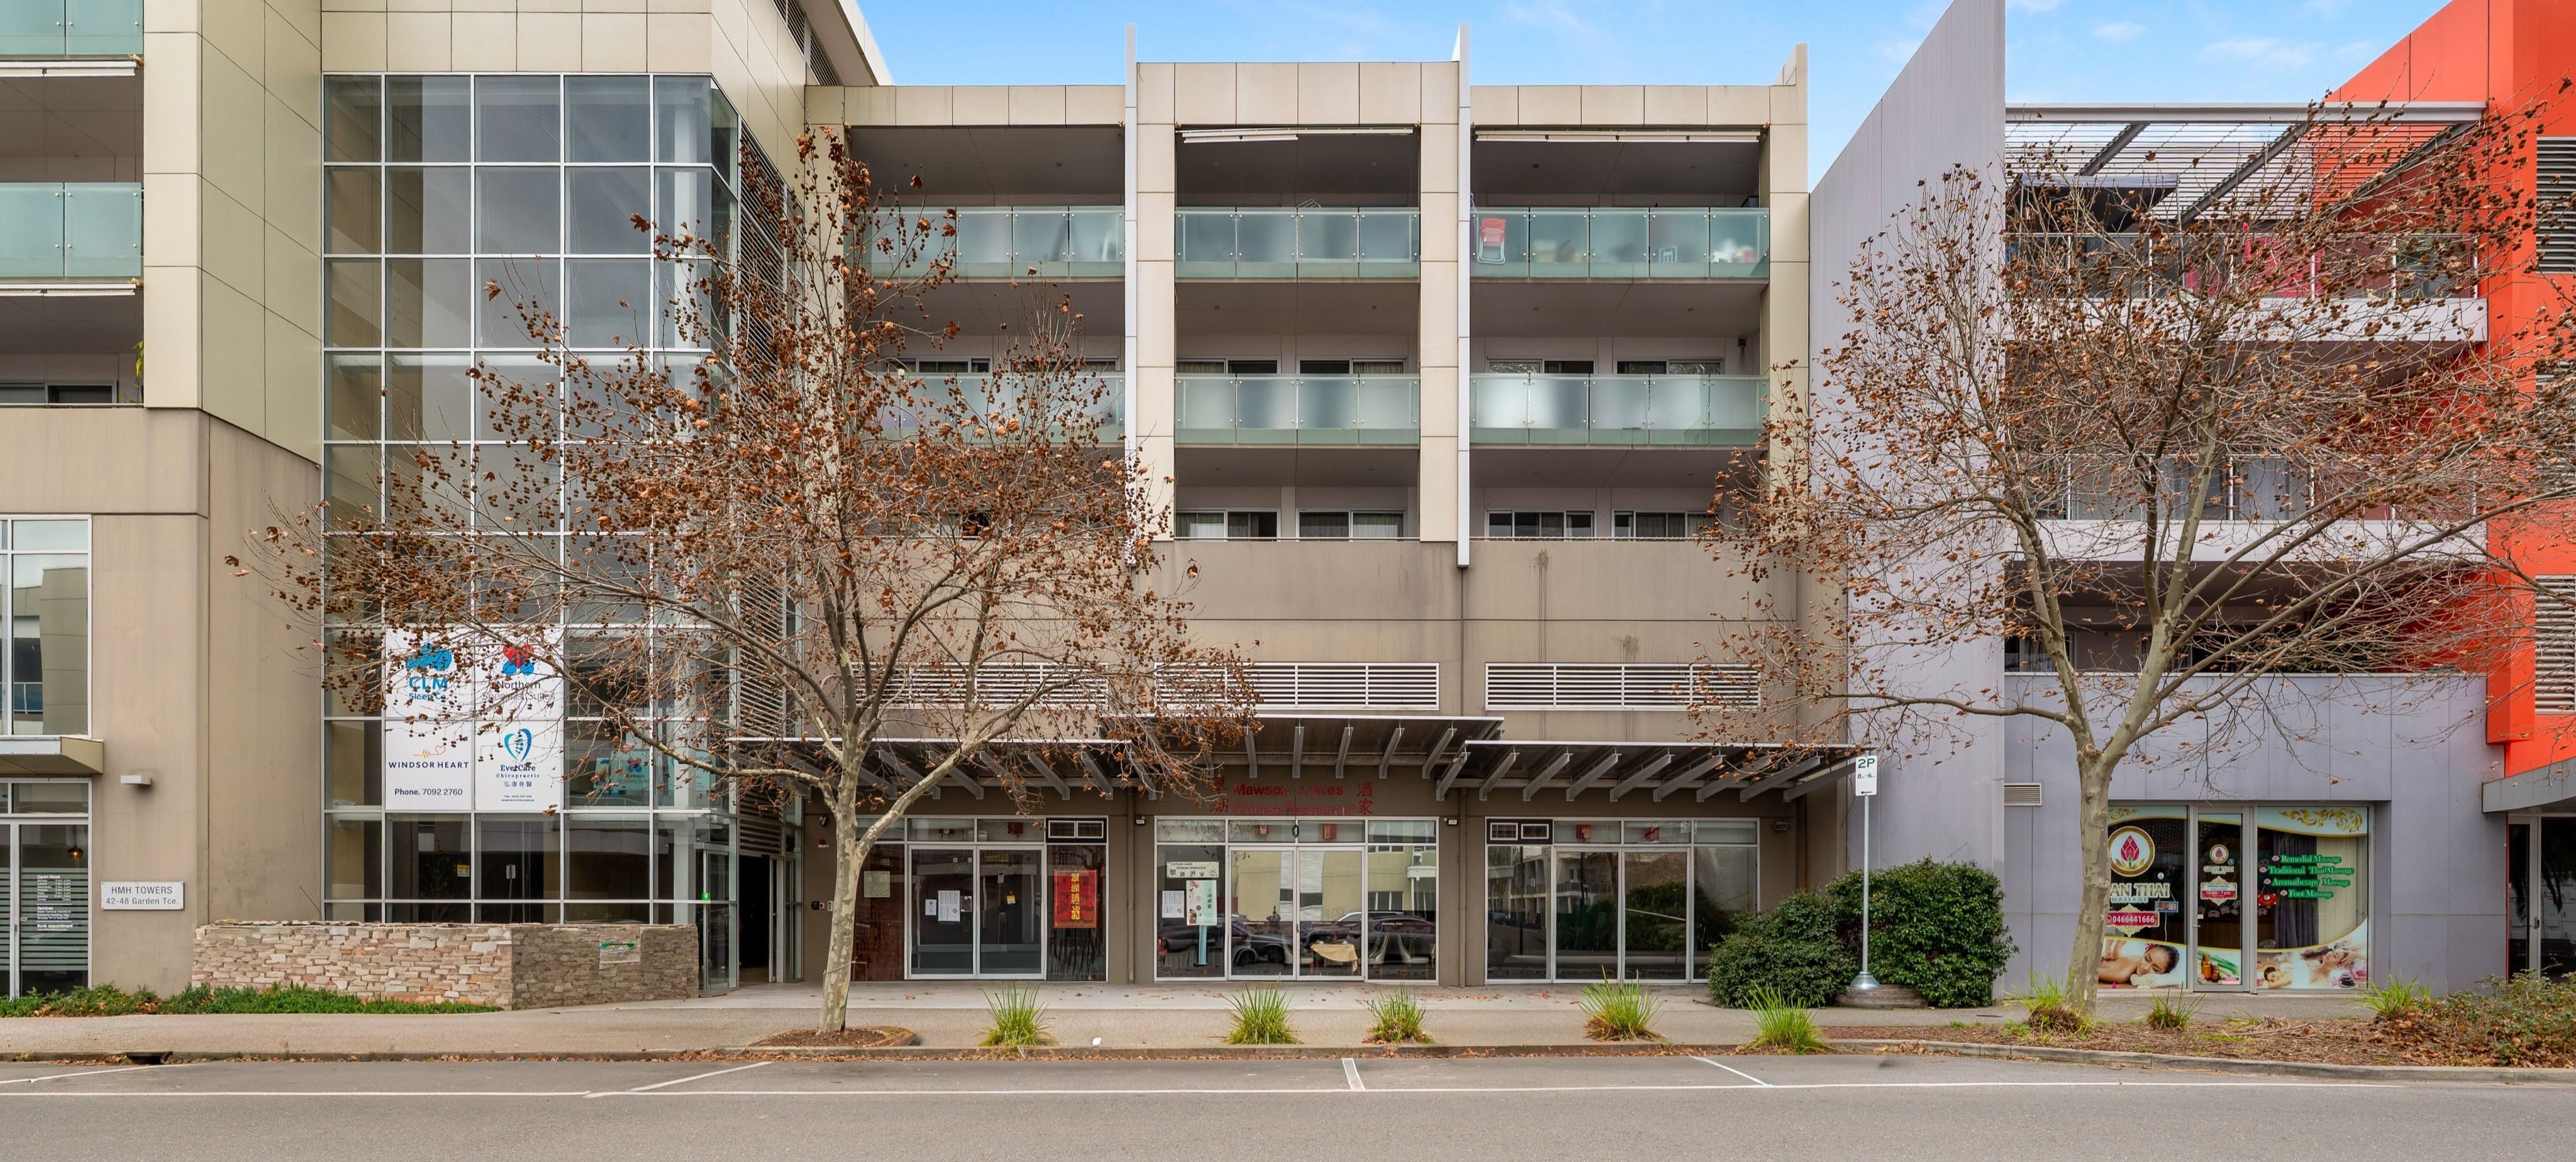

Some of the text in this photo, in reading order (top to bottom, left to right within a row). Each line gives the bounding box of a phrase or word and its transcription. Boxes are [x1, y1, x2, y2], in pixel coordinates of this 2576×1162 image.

[1858, 758, 1875, 768] 2P
[1233, 784, 1343, 795] Mawson Lakes
[1232, 802, 1355, 816] Chinese Restaurant
[2314, 855, 2341, 864] Massage
[2268, 866, 2354, 875] Traditional Thai Massage
[2272, 878, 2350, 888] Aromatherapy Massage
[111, 886, 173, 894] HMH TOWERS
[2135, 884, 2170, 897] THAI
[2307, 890, 2333, 899] Massage
[2112, 915, 2155, 924] 0466441666
